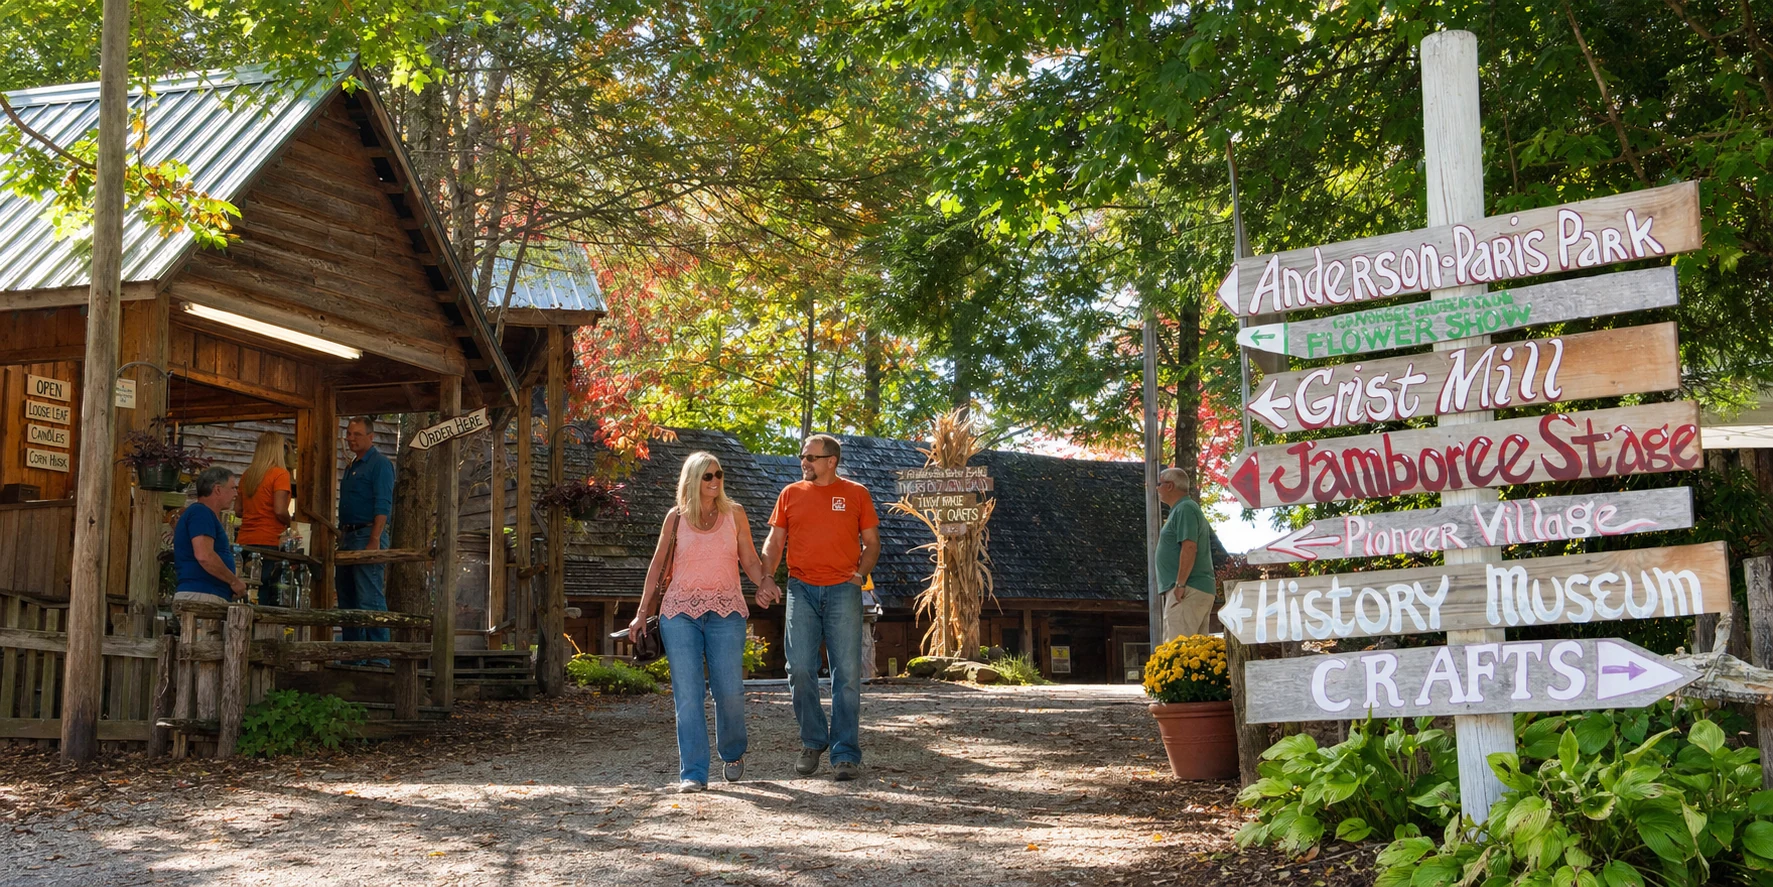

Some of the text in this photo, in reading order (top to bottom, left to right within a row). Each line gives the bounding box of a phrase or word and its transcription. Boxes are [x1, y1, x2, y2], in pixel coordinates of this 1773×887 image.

[1557, 208, 1666, 270] Park
[1306, 320, 1436, 357] FLOWER
[1446, 302, 1532, 339] SHOW
[28, 402, 69, 421] LOOSE LEAF
[36, 379, 63, 398] OPEN
[1294, 338, 1564, 431] Grist Mill
[31, 426, 65, 444] CANDLES
[418, 415, 483, 448] ORDER HERE
[1269, 413, 1700, 501] Jamboree Stage
[1344, 499, 1658, 557] Pioneer Village
[1311, 640, 1588, 713] CRAFTS
